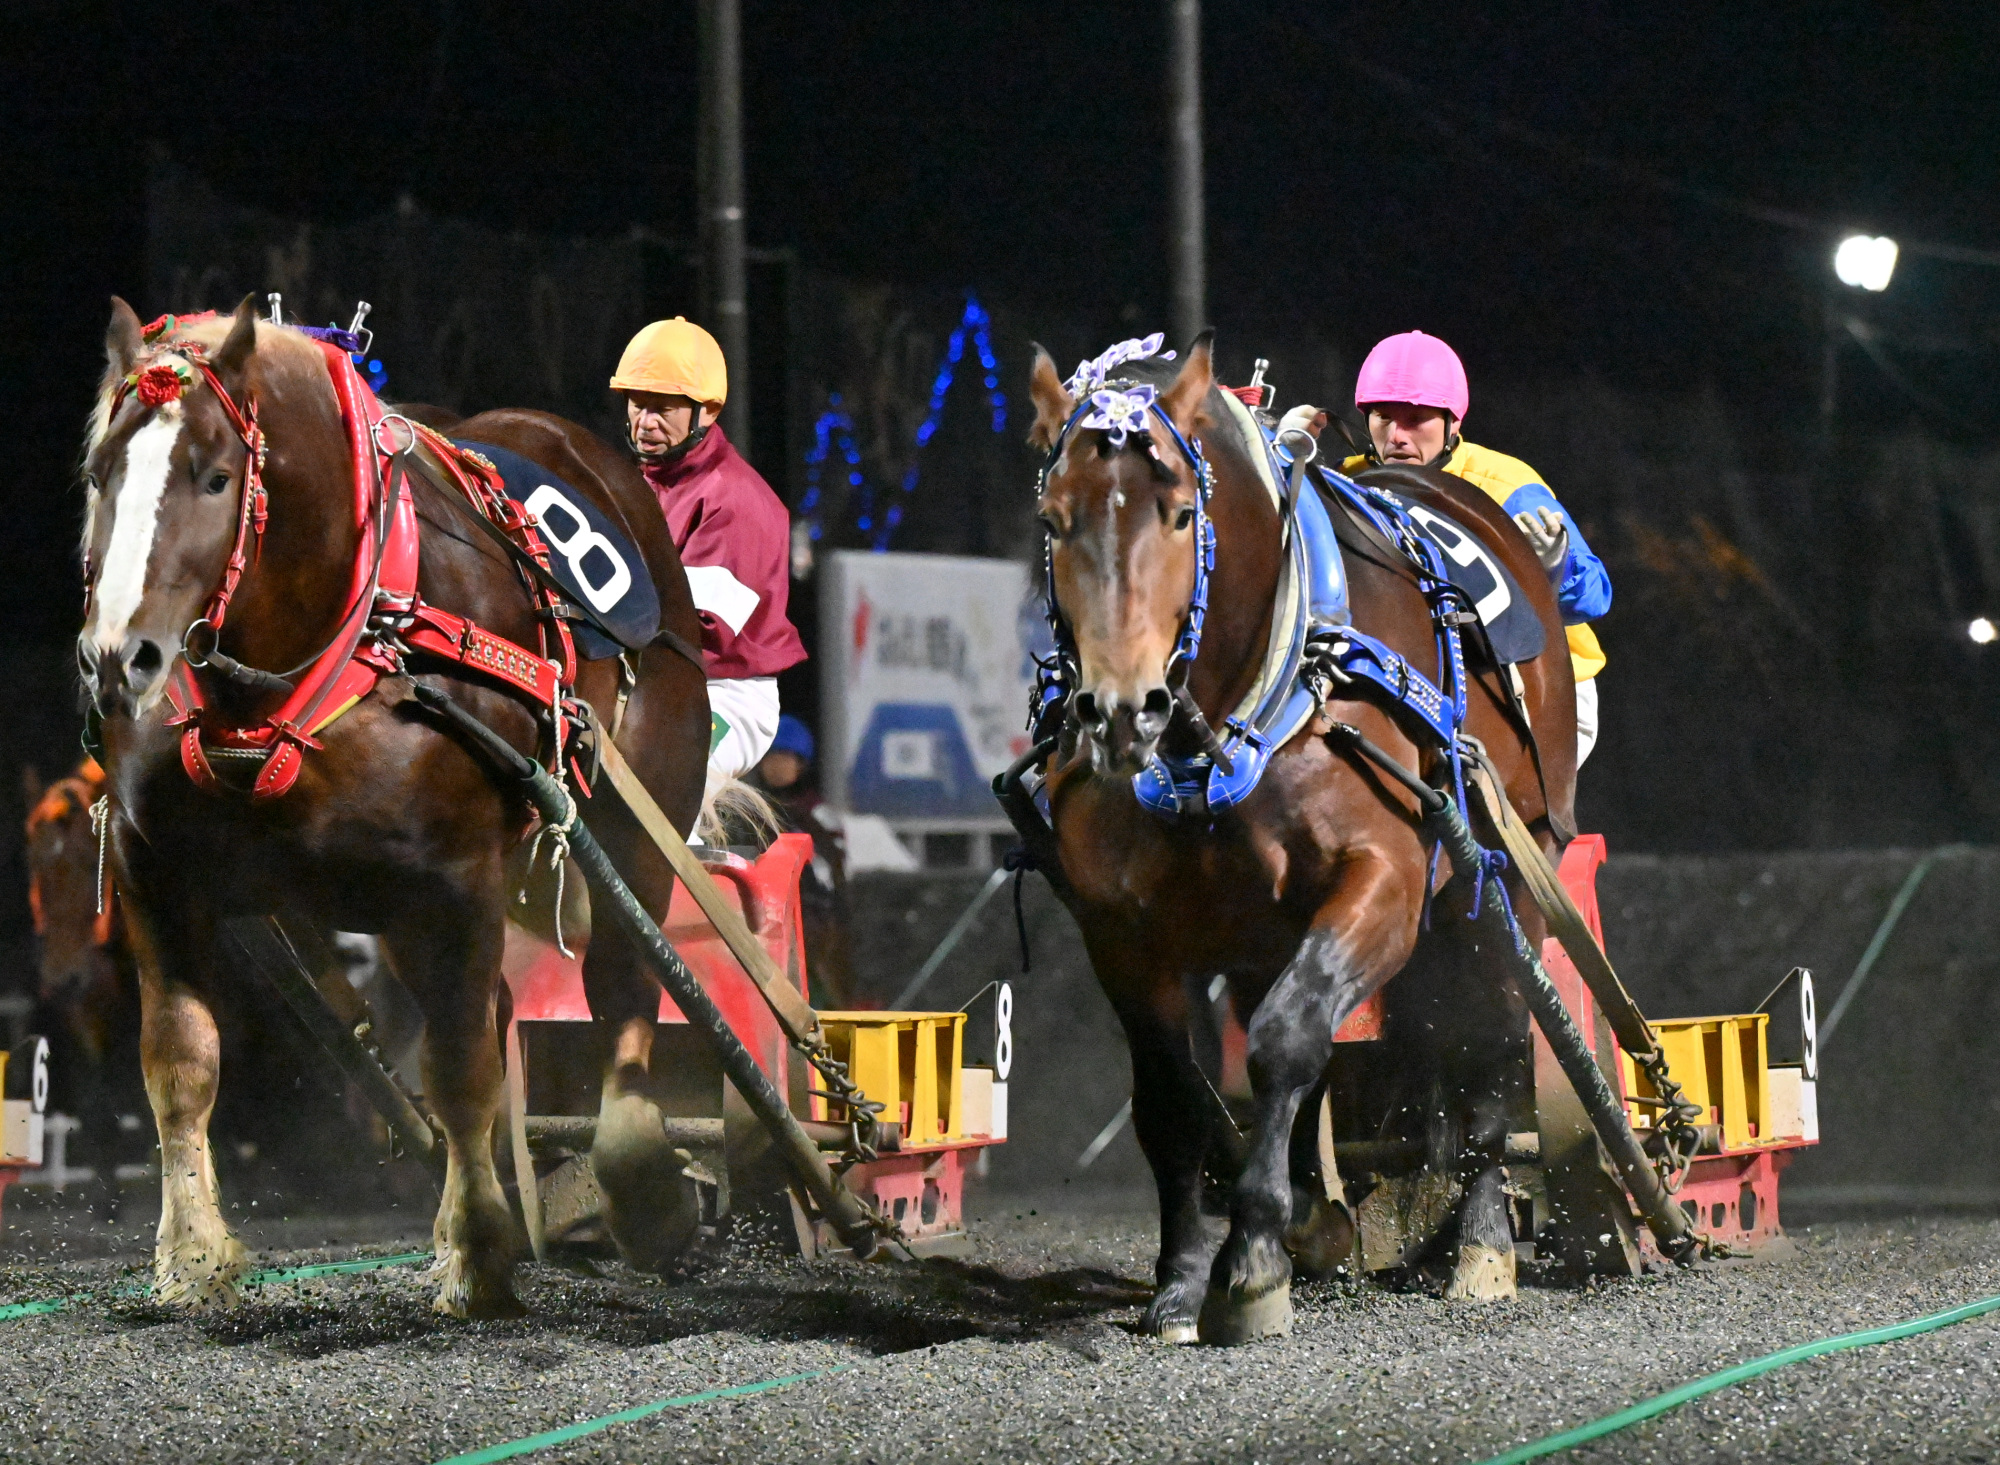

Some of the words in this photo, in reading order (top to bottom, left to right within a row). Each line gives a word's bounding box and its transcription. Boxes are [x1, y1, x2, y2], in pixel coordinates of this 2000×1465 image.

[524, 485, 632, 614] 8
[1407, 506, 1511, 627] 9
[33, 1037, 50, 1112] 6
[997, 983, 1012, 1080] 8
[1802, 970, 1817, 1078] 9
